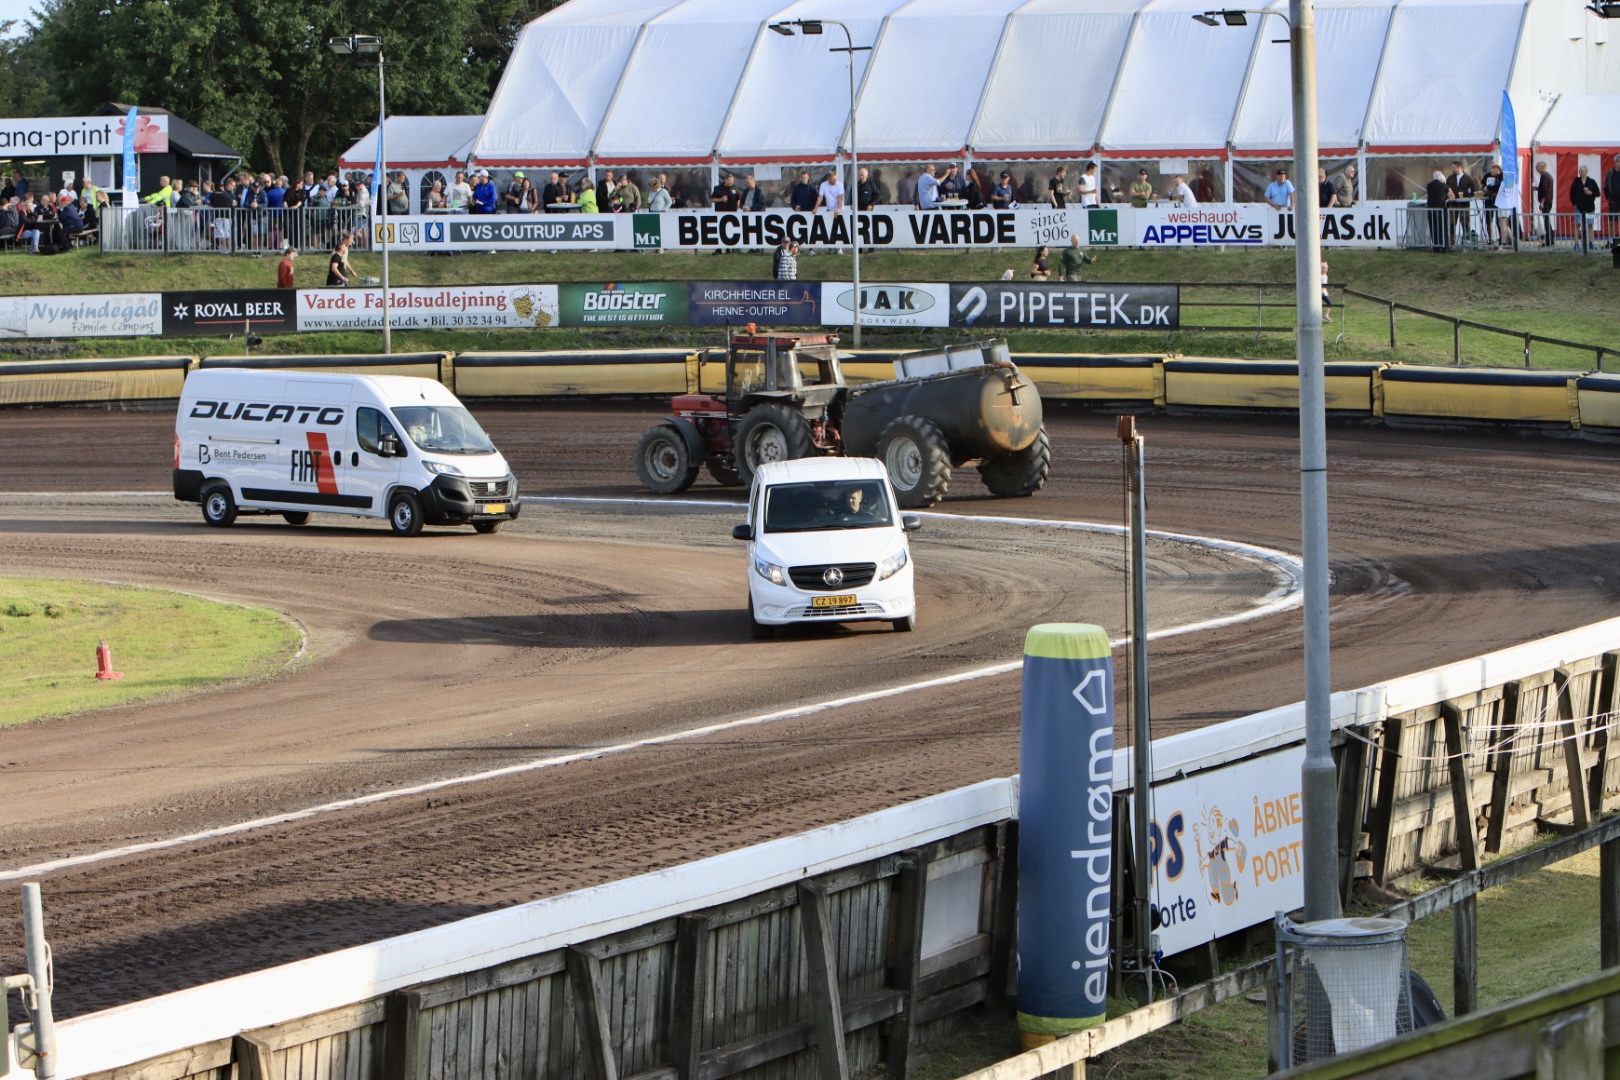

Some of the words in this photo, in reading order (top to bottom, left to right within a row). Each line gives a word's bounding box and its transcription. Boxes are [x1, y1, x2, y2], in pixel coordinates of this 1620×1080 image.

[678, 213, 894, 247] BECHSGAARD
[908, 212, 1016, 246] VARDE
[1030, 211, 1067, 230] since
[571, 223, 604, 239] APS
[634, 232, 660, 247] Mr
[1033, 224, 1070, 245] 1906
[1090, 229, 1117, 242] Mr
[303, 293, 356, 310] Varde
[364, 291, 507, 312] Fadølsudlejning
[704, 289, 776, 300] KIRCHHEINER
[778, 289, 791, 300] EL
[29, 299, 159, 324] Nymindegab
[194, 302, 242, 317] ROYAL
[245, 301, 285, 316] BEER
[627, 313, 664, 321] ATTITUDE
[999, 291, 1170, 325] PIPETEK.DK
[71, 321, 107, 333] Familie
[112, 320, 155, 334] Camping
[303, 316, 419, 329] www.vardefadel.dk
[451, 315, 463, 326] 30
[466, 315, 478, 326] 32
[480, 315, 492, 326] 34
[494, 315, 507, 326] 94
[189, 400, 345, 426] DUCATO
[214, 448, 231, 459] Bent
[233, 449, 267, 461] Pedersen
[290, 449, 322, 483] FIAT
[815, 598, 826, 606] CZ
[828, 597, 838, 605] 19
[838, 596, 853, 605] 897
[1253, 791, 1304, 838] ÅBNE
[1070, 726, 1113, 1005] eiendrøm
[1252, 841, 1305, 888] PORT
